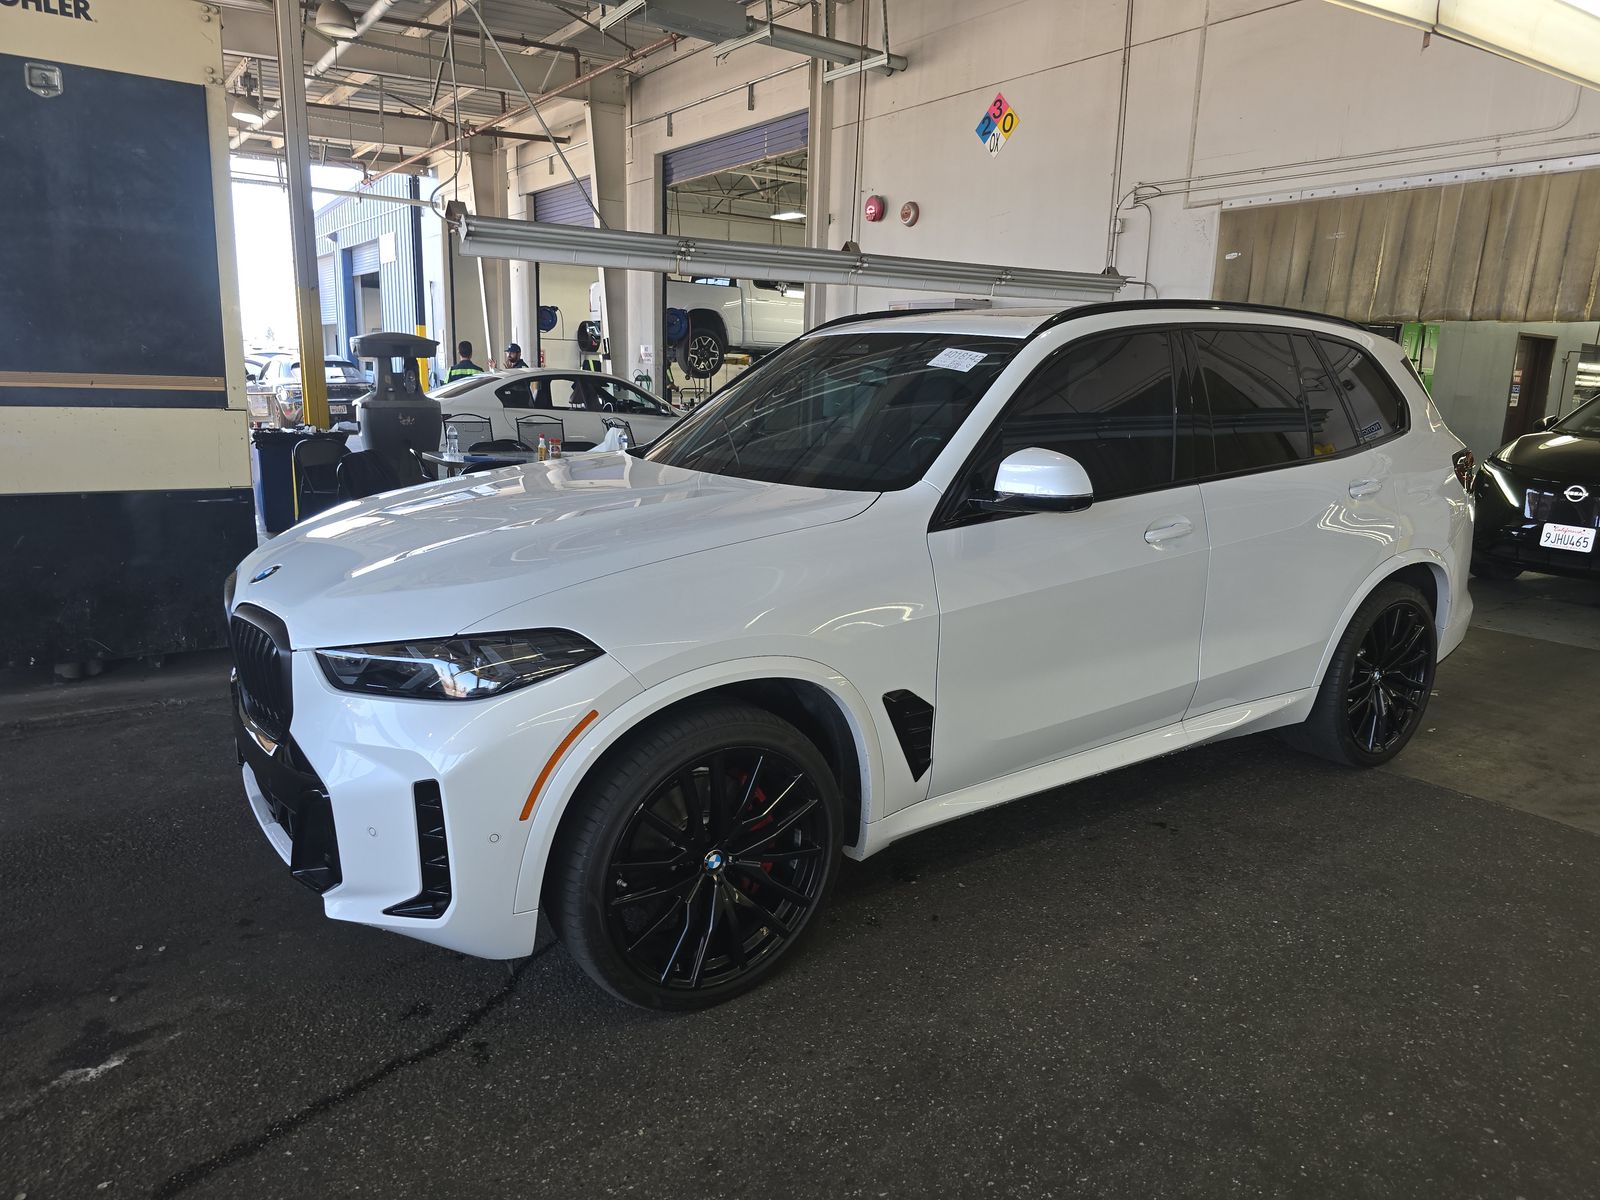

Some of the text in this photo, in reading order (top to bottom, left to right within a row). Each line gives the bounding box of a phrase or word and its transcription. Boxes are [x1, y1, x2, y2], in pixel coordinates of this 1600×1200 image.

[992, 99, 1002, 119] 3
[982, 116, 991, 136] 2
[1544, 532, 1589, 549] 9JHU465
